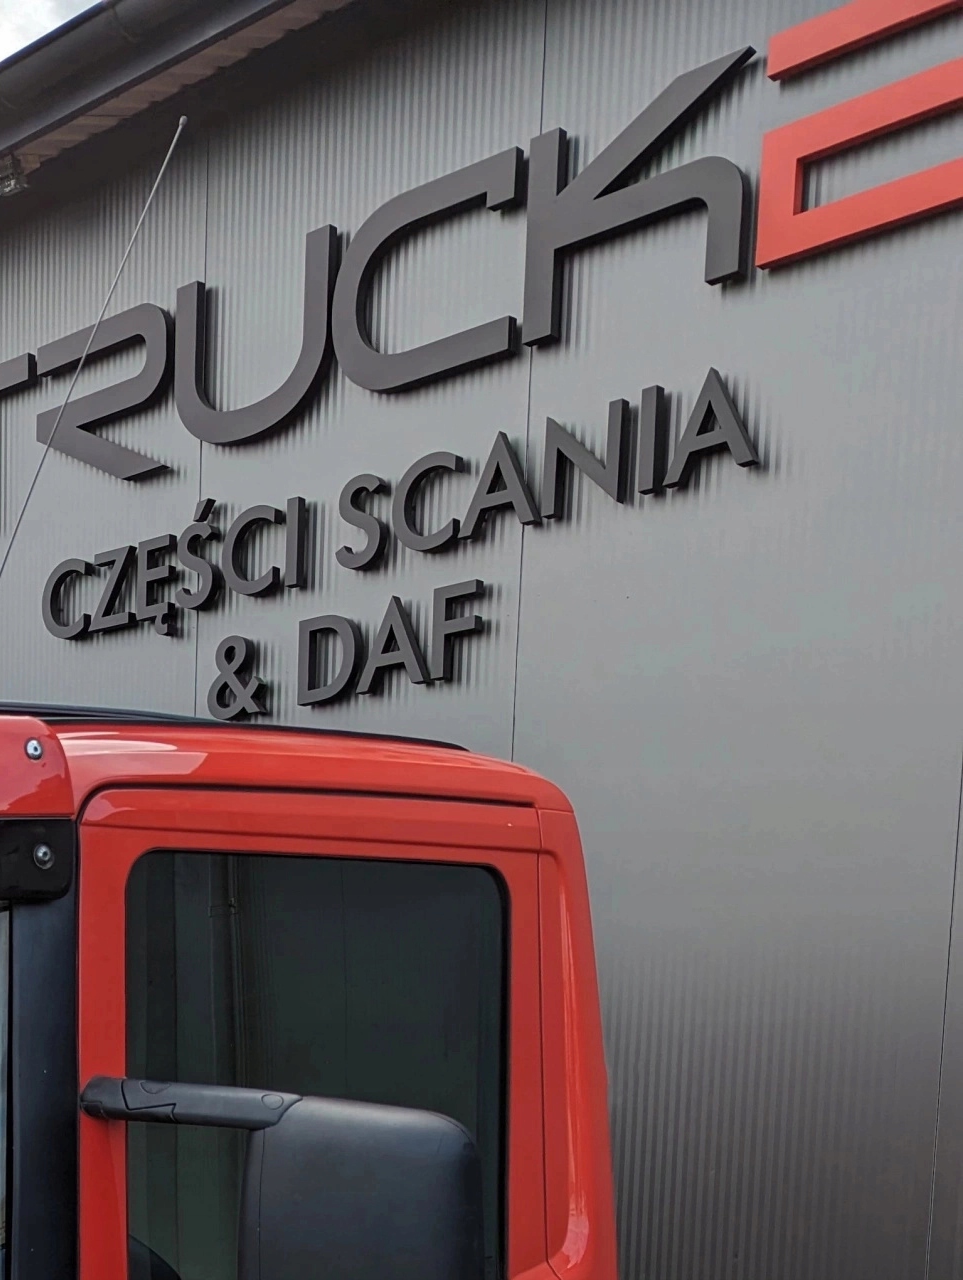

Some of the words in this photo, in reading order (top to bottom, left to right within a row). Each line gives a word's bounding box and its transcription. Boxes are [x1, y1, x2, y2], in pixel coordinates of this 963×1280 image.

[42, 496, 305, 640] CZĘŚCI
[335, 367, 758, 571] SCANIA
[207, 635, 266, 720] &
[298, 579, 484, 706] DAF
